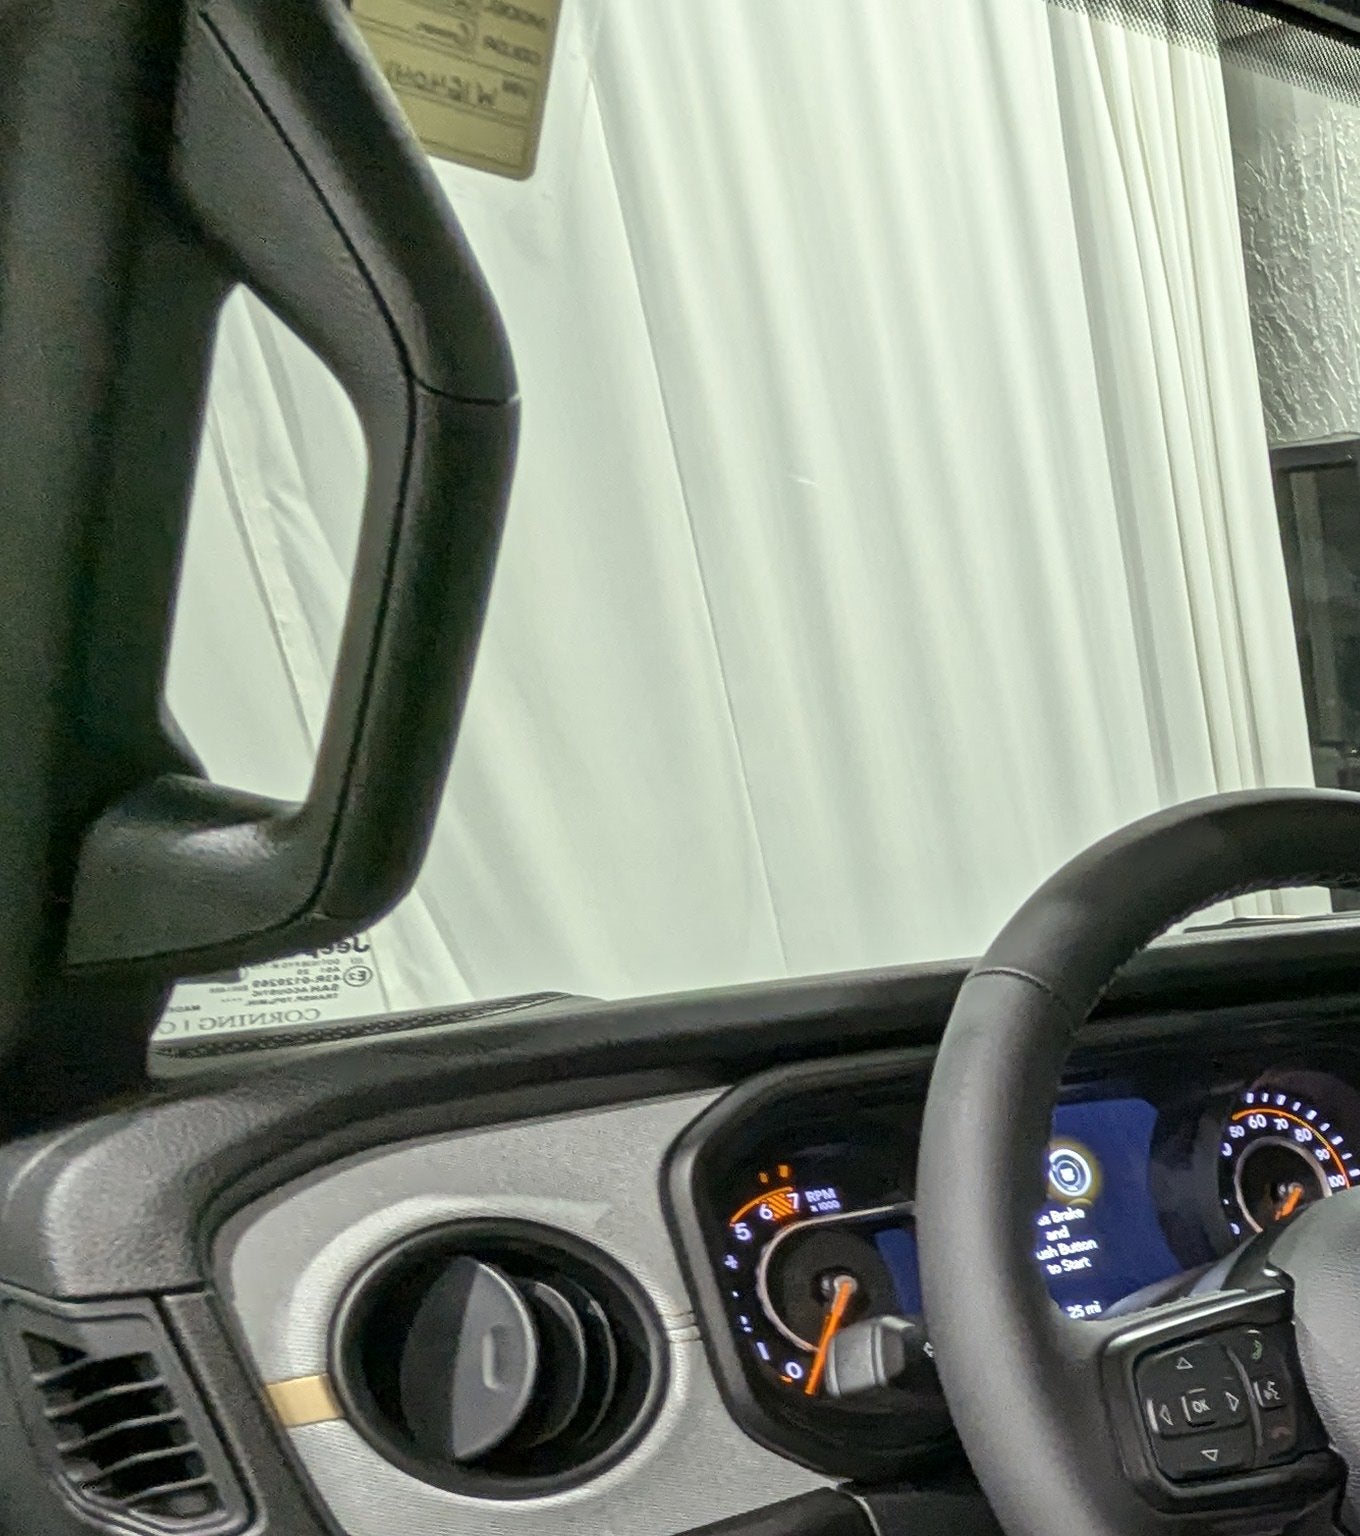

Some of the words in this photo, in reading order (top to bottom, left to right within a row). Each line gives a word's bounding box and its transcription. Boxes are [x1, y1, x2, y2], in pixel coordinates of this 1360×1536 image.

[1248, 1114, 1267, 1129] 60
[1273, 1117, 1290, 1131] 70
[1228, 1124, 1246, 1139] 50
[1293, 1127, 1313, 1143] 80
[1314, 1147, 1331, 1161] 90
[1327, 1174, 1346, 1188] 100
[786, 1193, 800, 1210] 7
[804, 1188, 837, 1203] RPM
[758, 1204, 774, 1221] 6
[1049, 1207, 1086, 1224] Brake
[734, 1222, 753, 1241] 5
[1044, 1225, 1071, 1242] and
[1035, 1244, 1059, 1261] ush
[1058, 1238, 1100, 1255] Button
[1046, 1261, 1062, 1275] to
[1061, 1256, 1093, 1272] Start
[1085, 1300, 1103, 1315] mi
[784, 1361, 803, 1379] 0
[1192, 1398, 1212, 1414] OK
